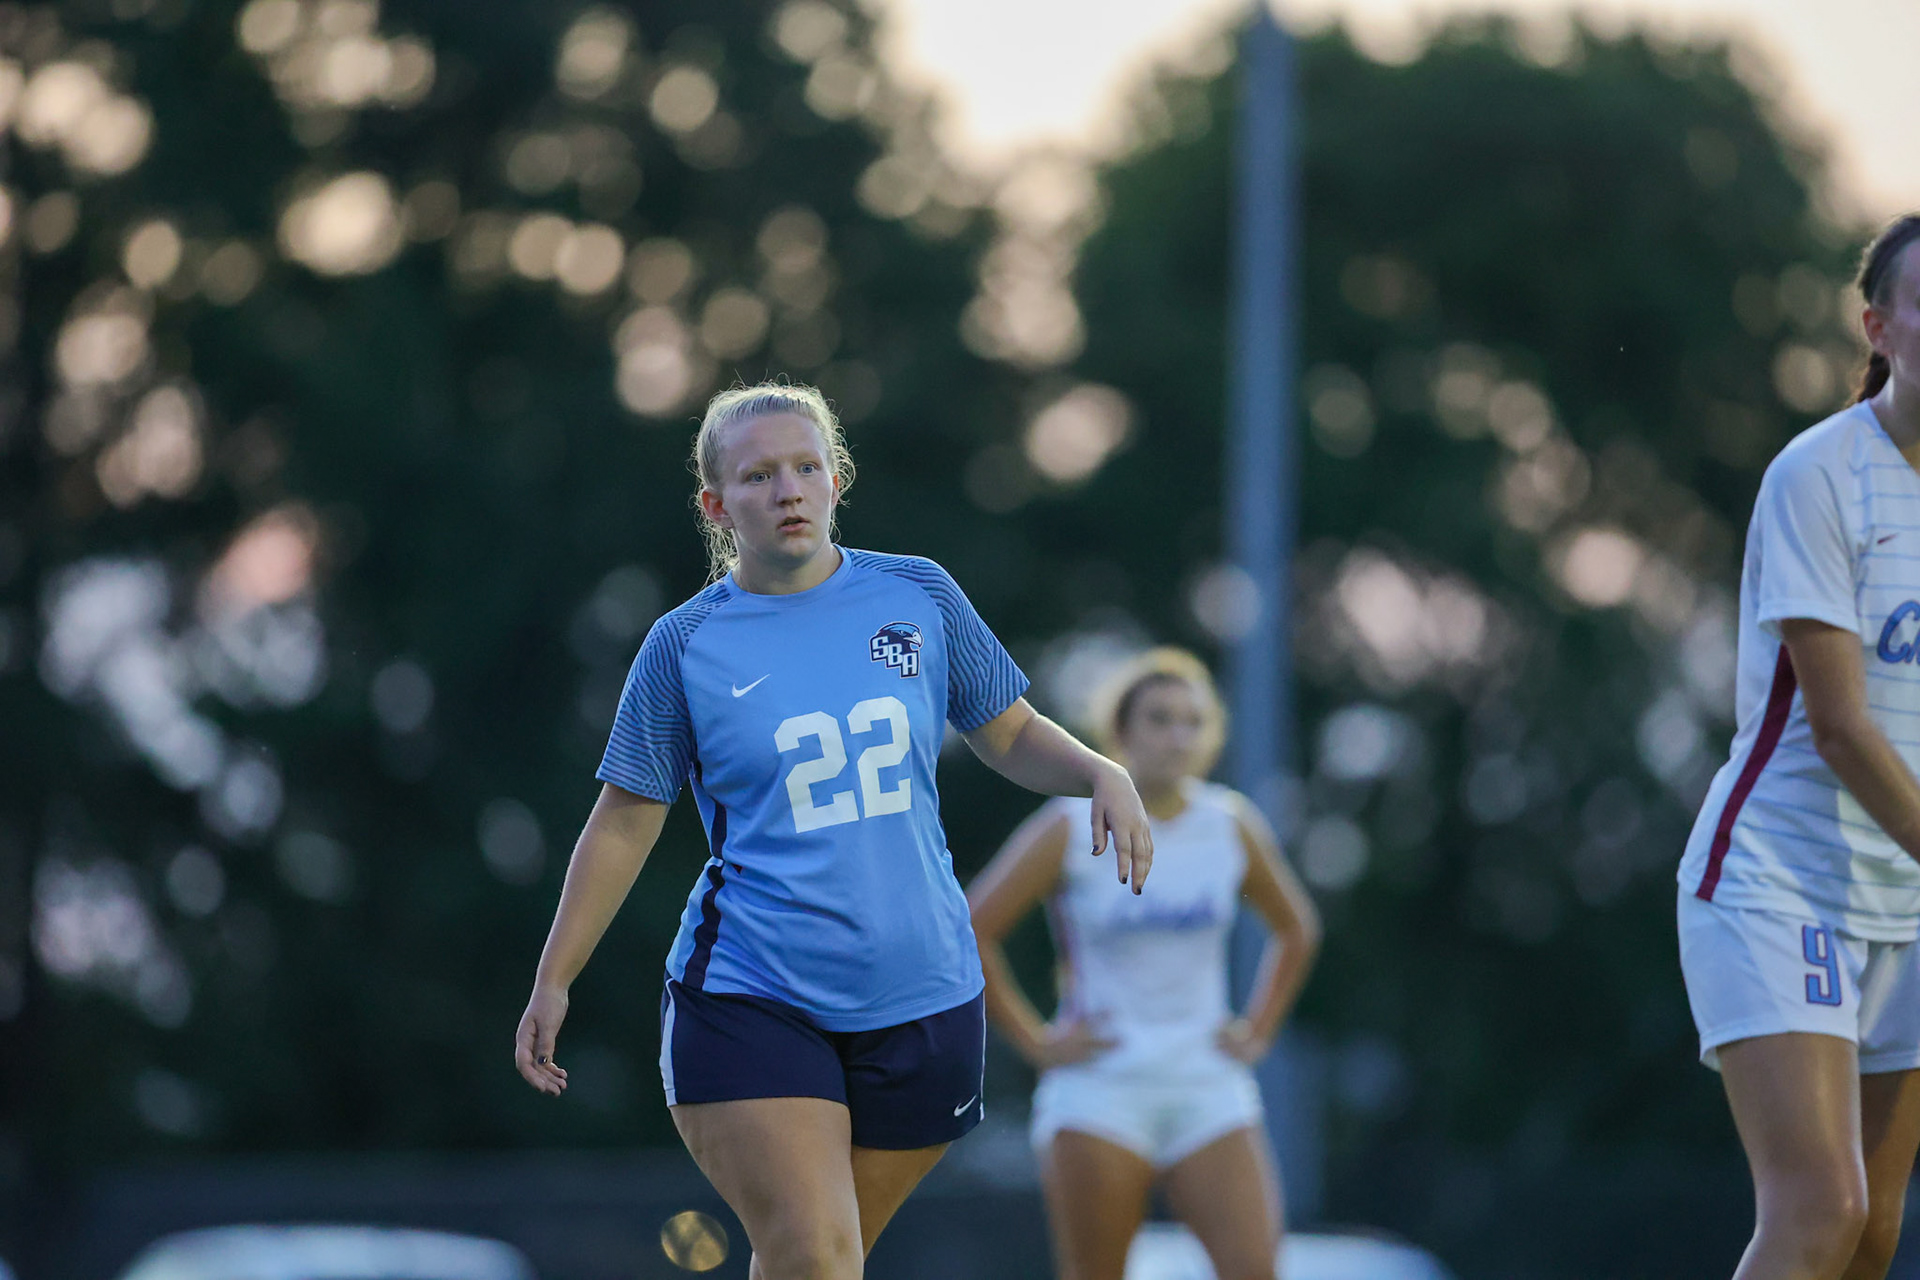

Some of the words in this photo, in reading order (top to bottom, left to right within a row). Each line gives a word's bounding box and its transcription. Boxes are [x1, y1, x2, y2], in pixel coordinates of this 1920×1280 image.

[871, 635, 918, 676] SBA
[773, 695, 912, 834] 22
[1802, 924, 1842, 1007] 9
